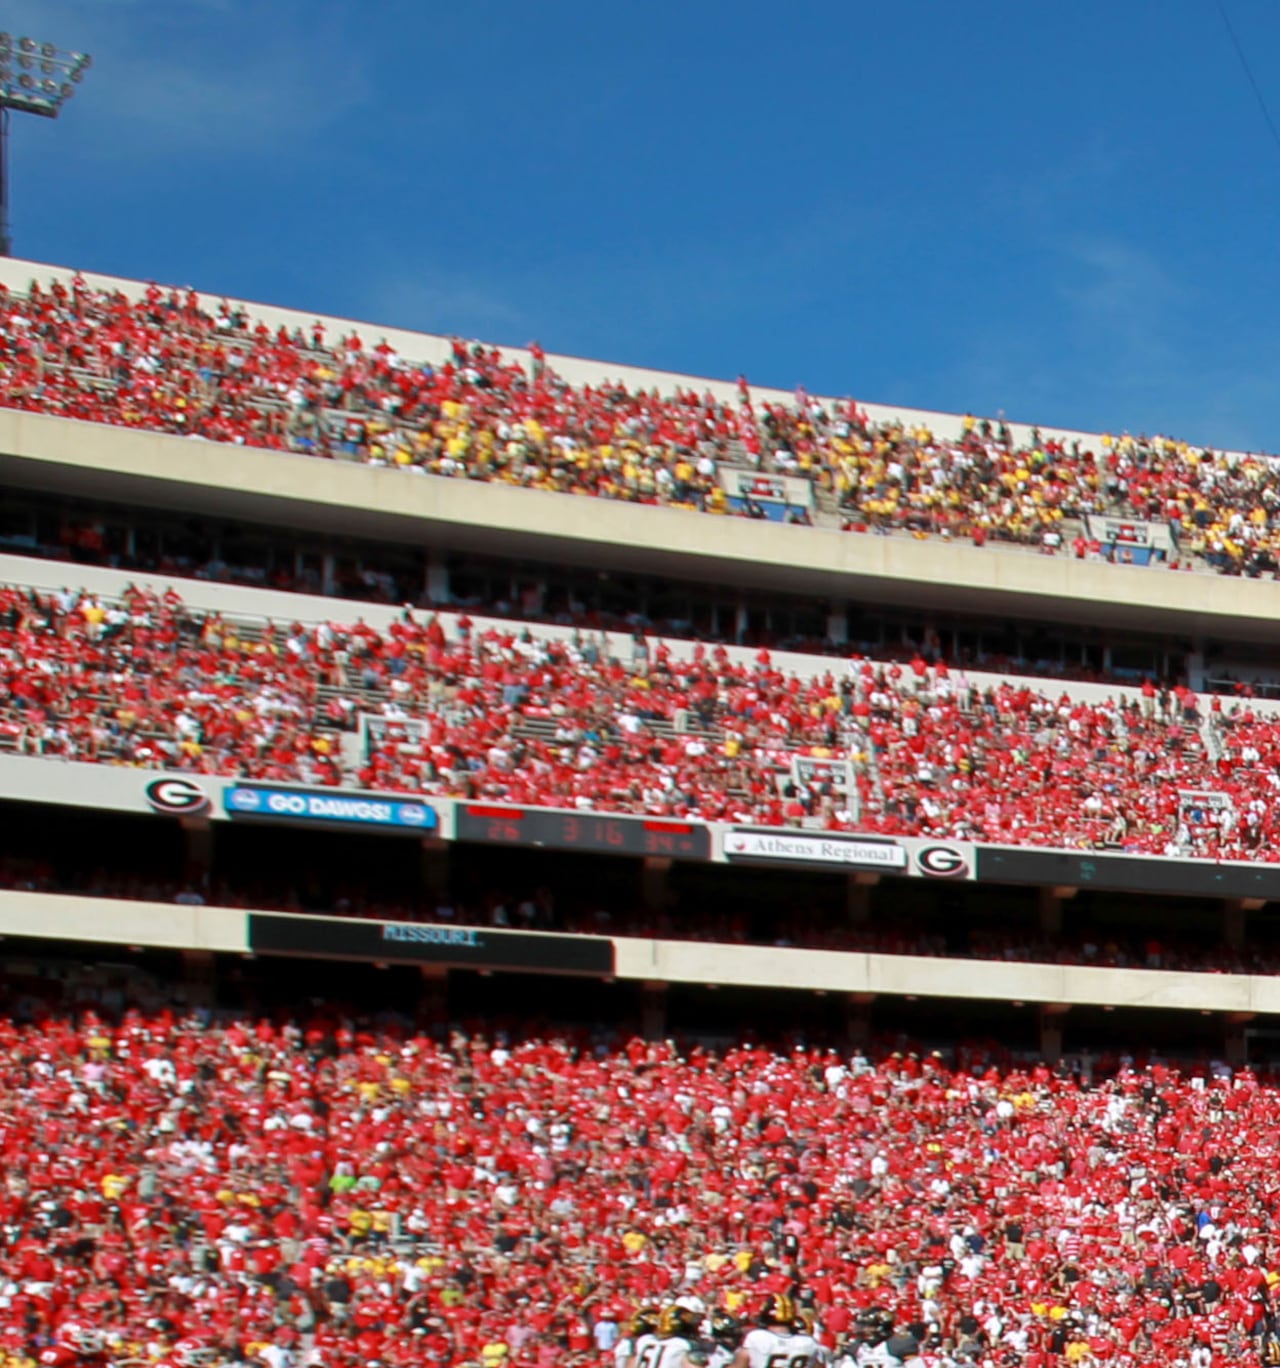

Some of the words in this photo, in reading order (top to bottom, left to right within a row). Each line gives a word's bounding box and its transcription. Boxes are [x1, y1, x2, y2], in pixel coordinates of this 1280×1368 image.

[269, 794, 304, 813] GO
[309, 799, 392, 820] DAWGS!
[754, 839, 814, 856] Athens
[821, 844, 895, 863] Regional
